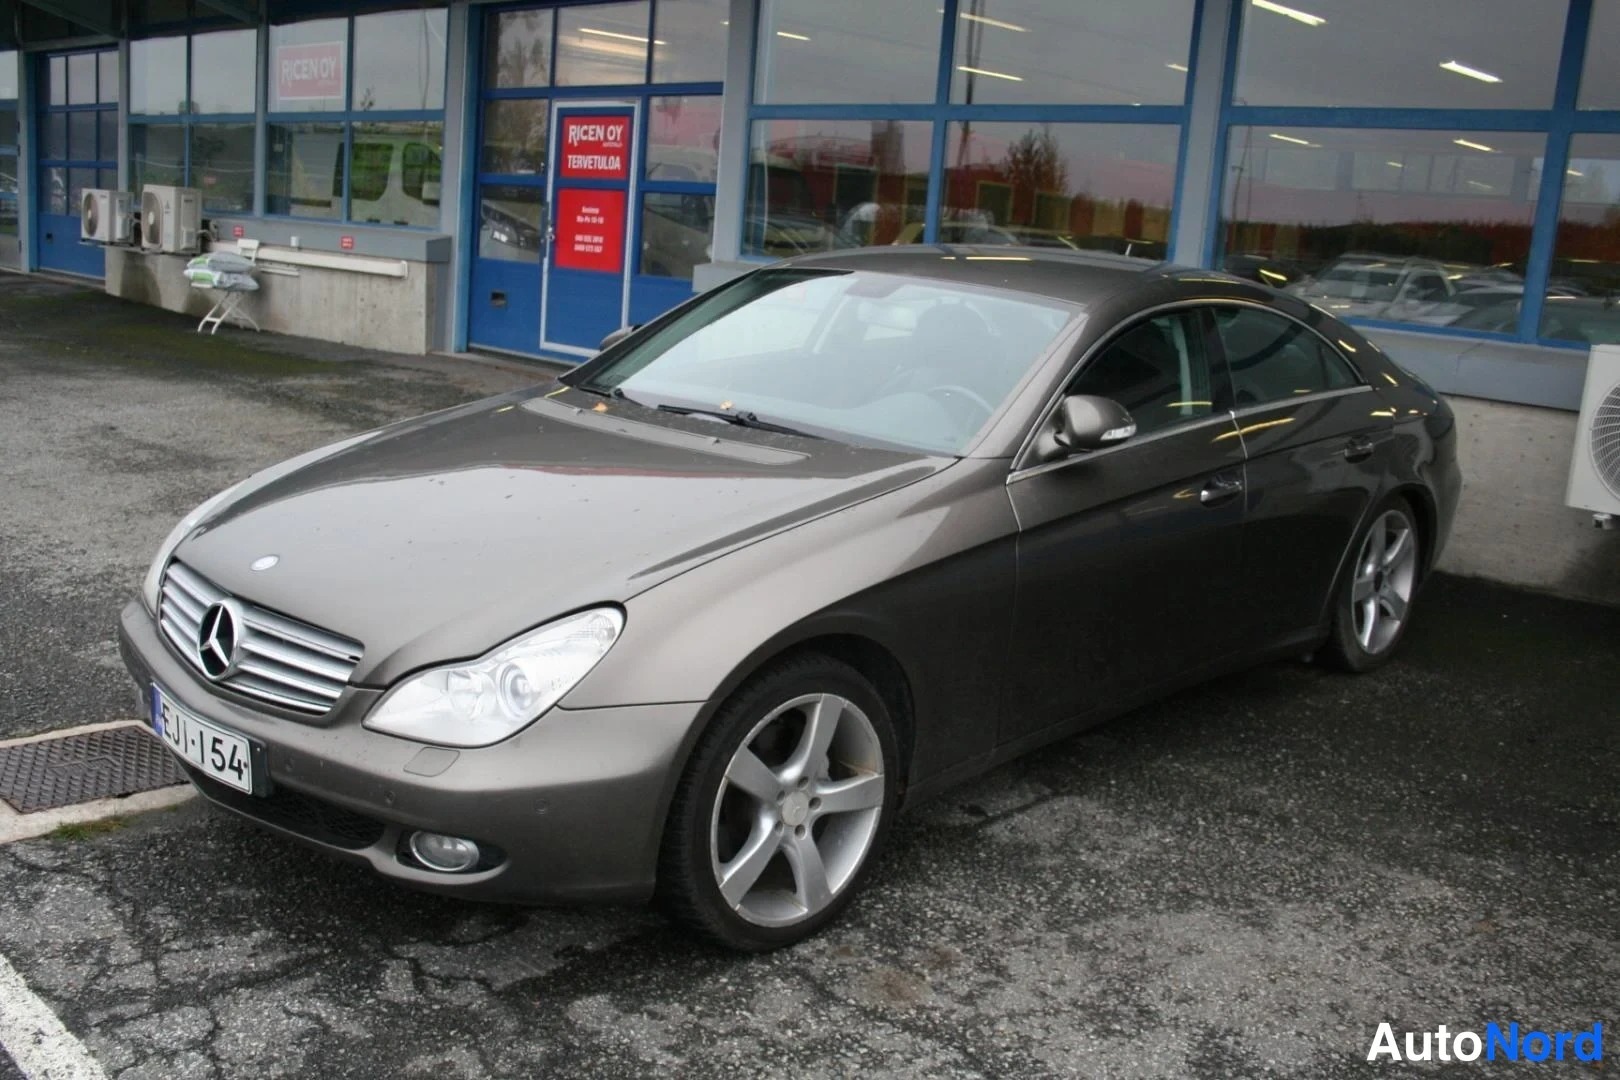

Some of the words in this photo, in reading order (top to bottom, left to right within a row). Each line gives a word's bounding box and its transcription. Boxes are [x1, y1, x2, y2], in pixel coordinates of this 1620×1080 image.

[281, 58, 318, 88] RICEN
[320, 56, 337, 79] OY
[568, 125, 605, 147] RICEN
[607, 125, 624, 141] OY
[567, 154, 621, 170] TERVETULOA
